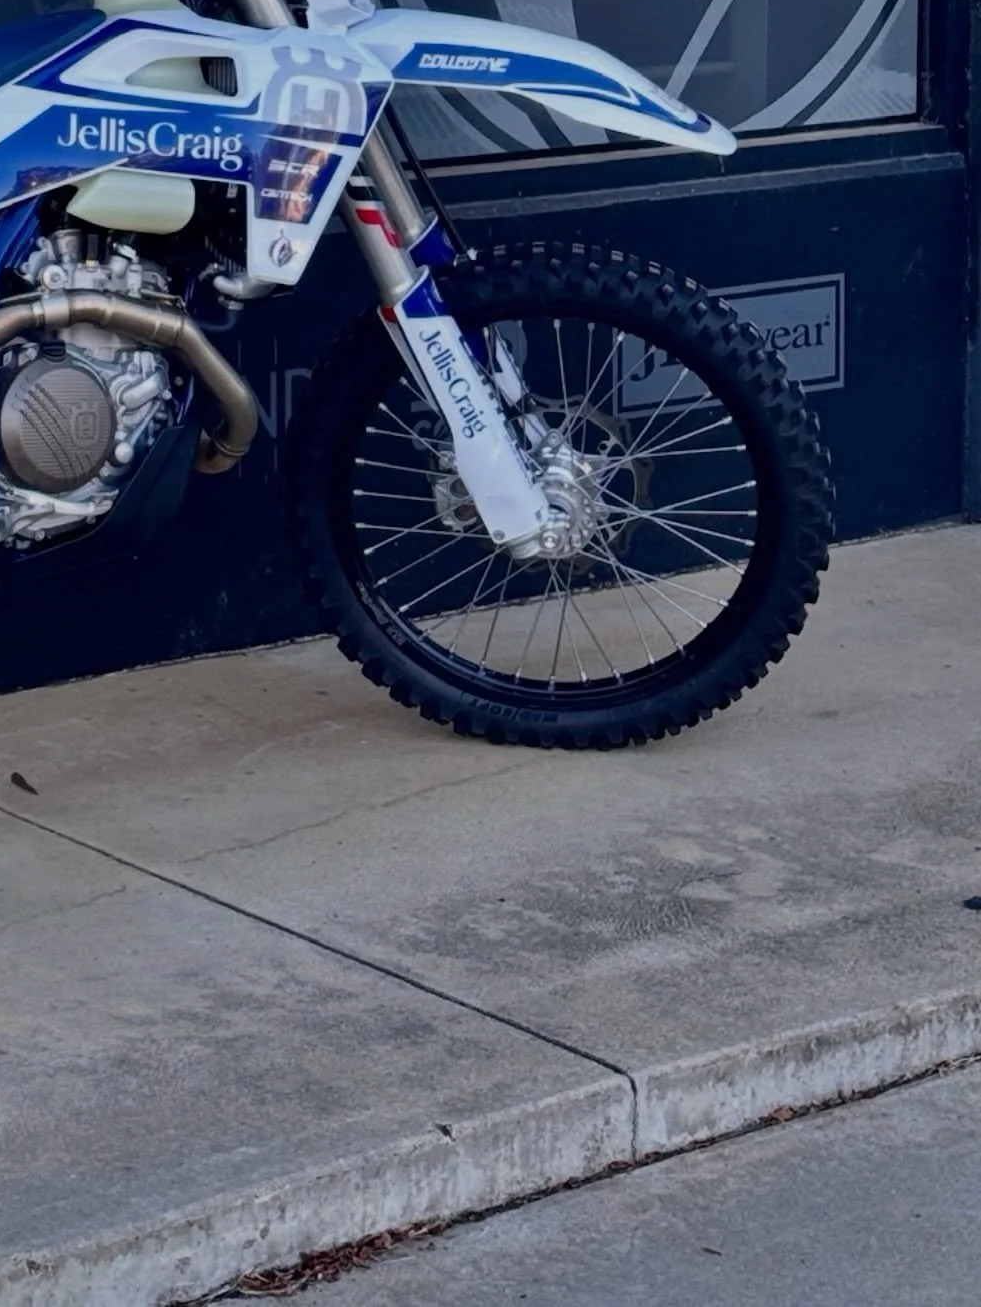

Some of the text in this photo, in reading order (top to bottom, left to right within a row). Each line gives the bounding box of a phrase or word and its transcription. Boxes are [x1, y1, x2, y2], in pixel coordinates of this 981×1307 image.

[418, 53, 510, 73] COLLECTIVE
[56, 111, 245, 173] JellisCraig
[417, 328, 488, 439] JellisCraig
